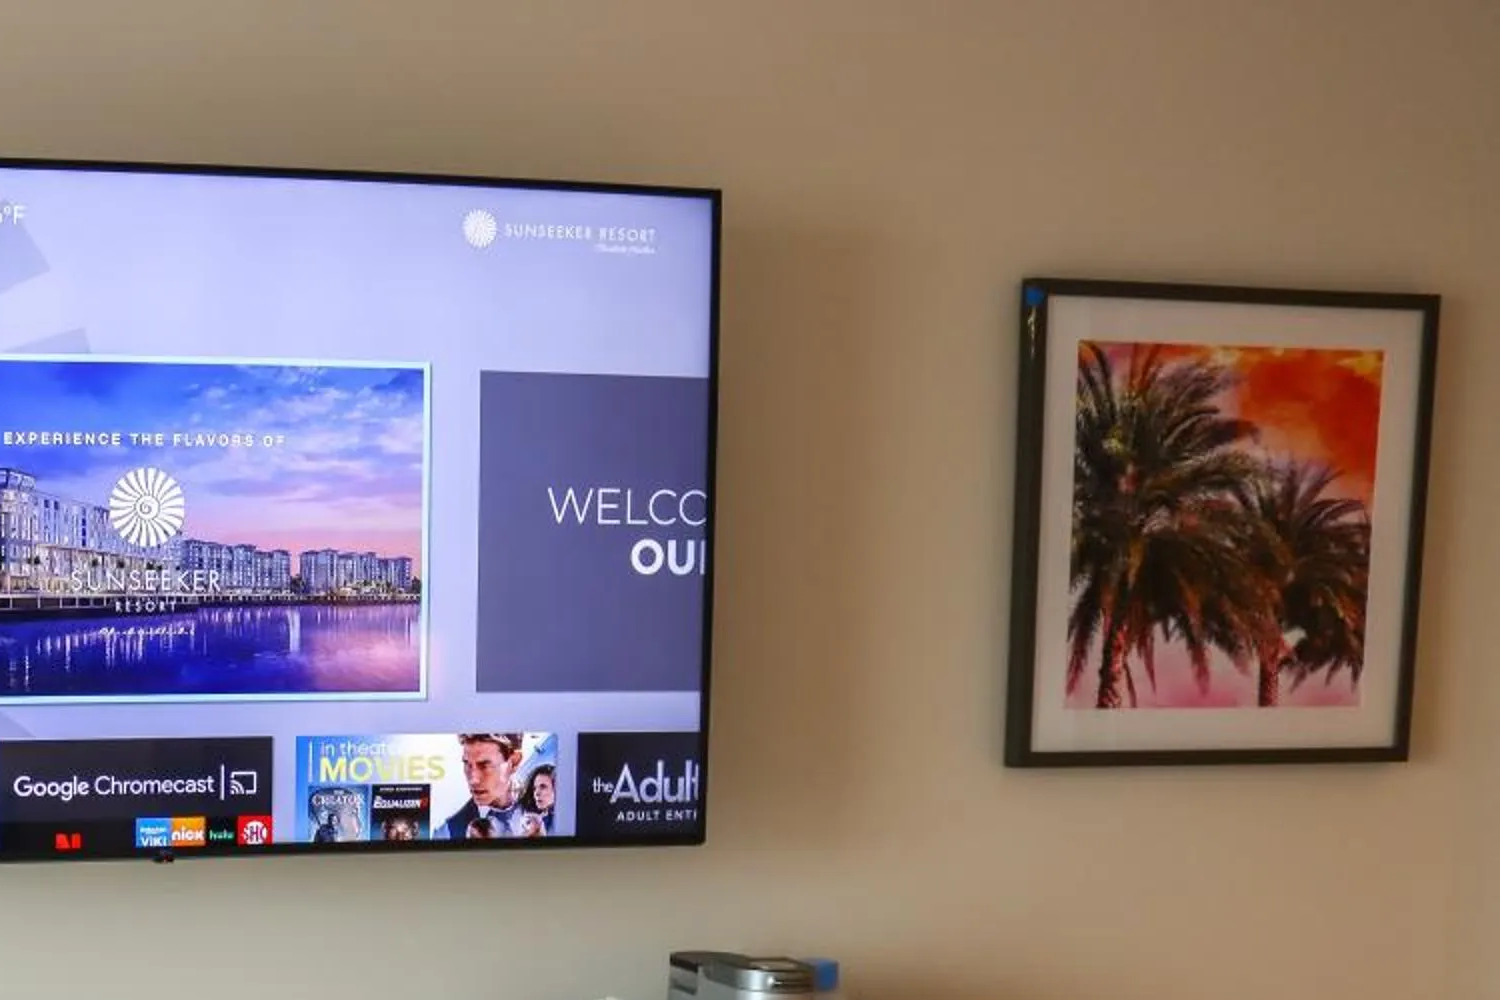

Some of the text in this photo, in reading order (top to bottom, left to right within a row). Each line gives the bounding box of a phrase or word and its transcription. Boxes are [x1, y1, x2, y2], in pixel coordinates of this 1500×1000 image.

[504, 223, 657, 243] SUNSEEKER RESORT
[3, 431, 285, 447] EXPERIENCE THE FLAVORS OF
[630, 539, 705, 576] OU
[71, 569, 221, 592] SUNSEEKER
[115, 601, 176, 613] RESORT
[320, 756, 446, 783] MOVIES
[13, 775, 215, 801] Google Chromecast
[592, 776, 614, 793] the
[617, 810, 660, 821] ADULT
